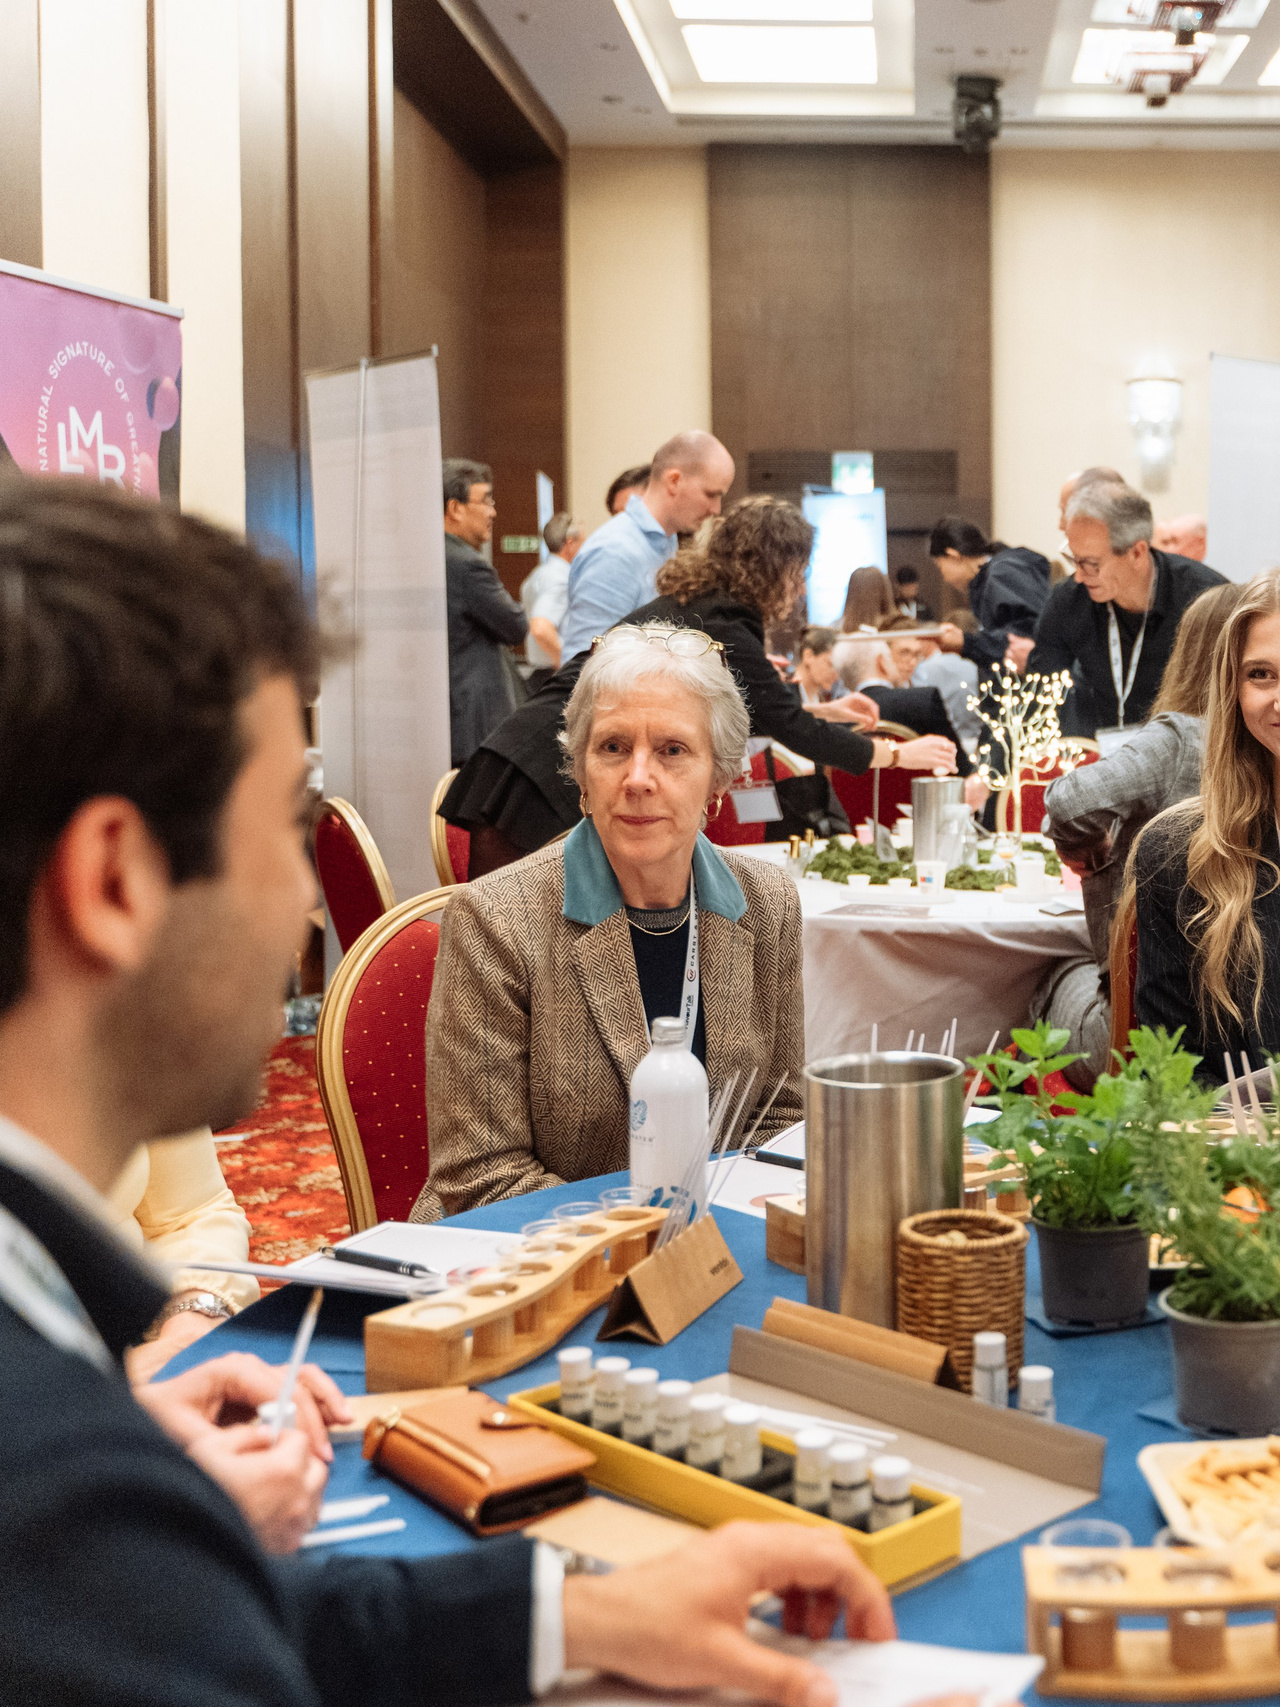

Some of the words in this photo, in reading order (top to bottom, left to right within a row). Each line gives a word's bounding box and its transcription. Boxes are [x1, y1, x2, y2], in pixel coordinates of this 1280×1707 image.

[37, 384, 54, 471] NATURAL
[48, 341, 115, 380] SIGNATURE
[115, 377, 130, 403] OF
[57, 405, 126, 489] LMR
